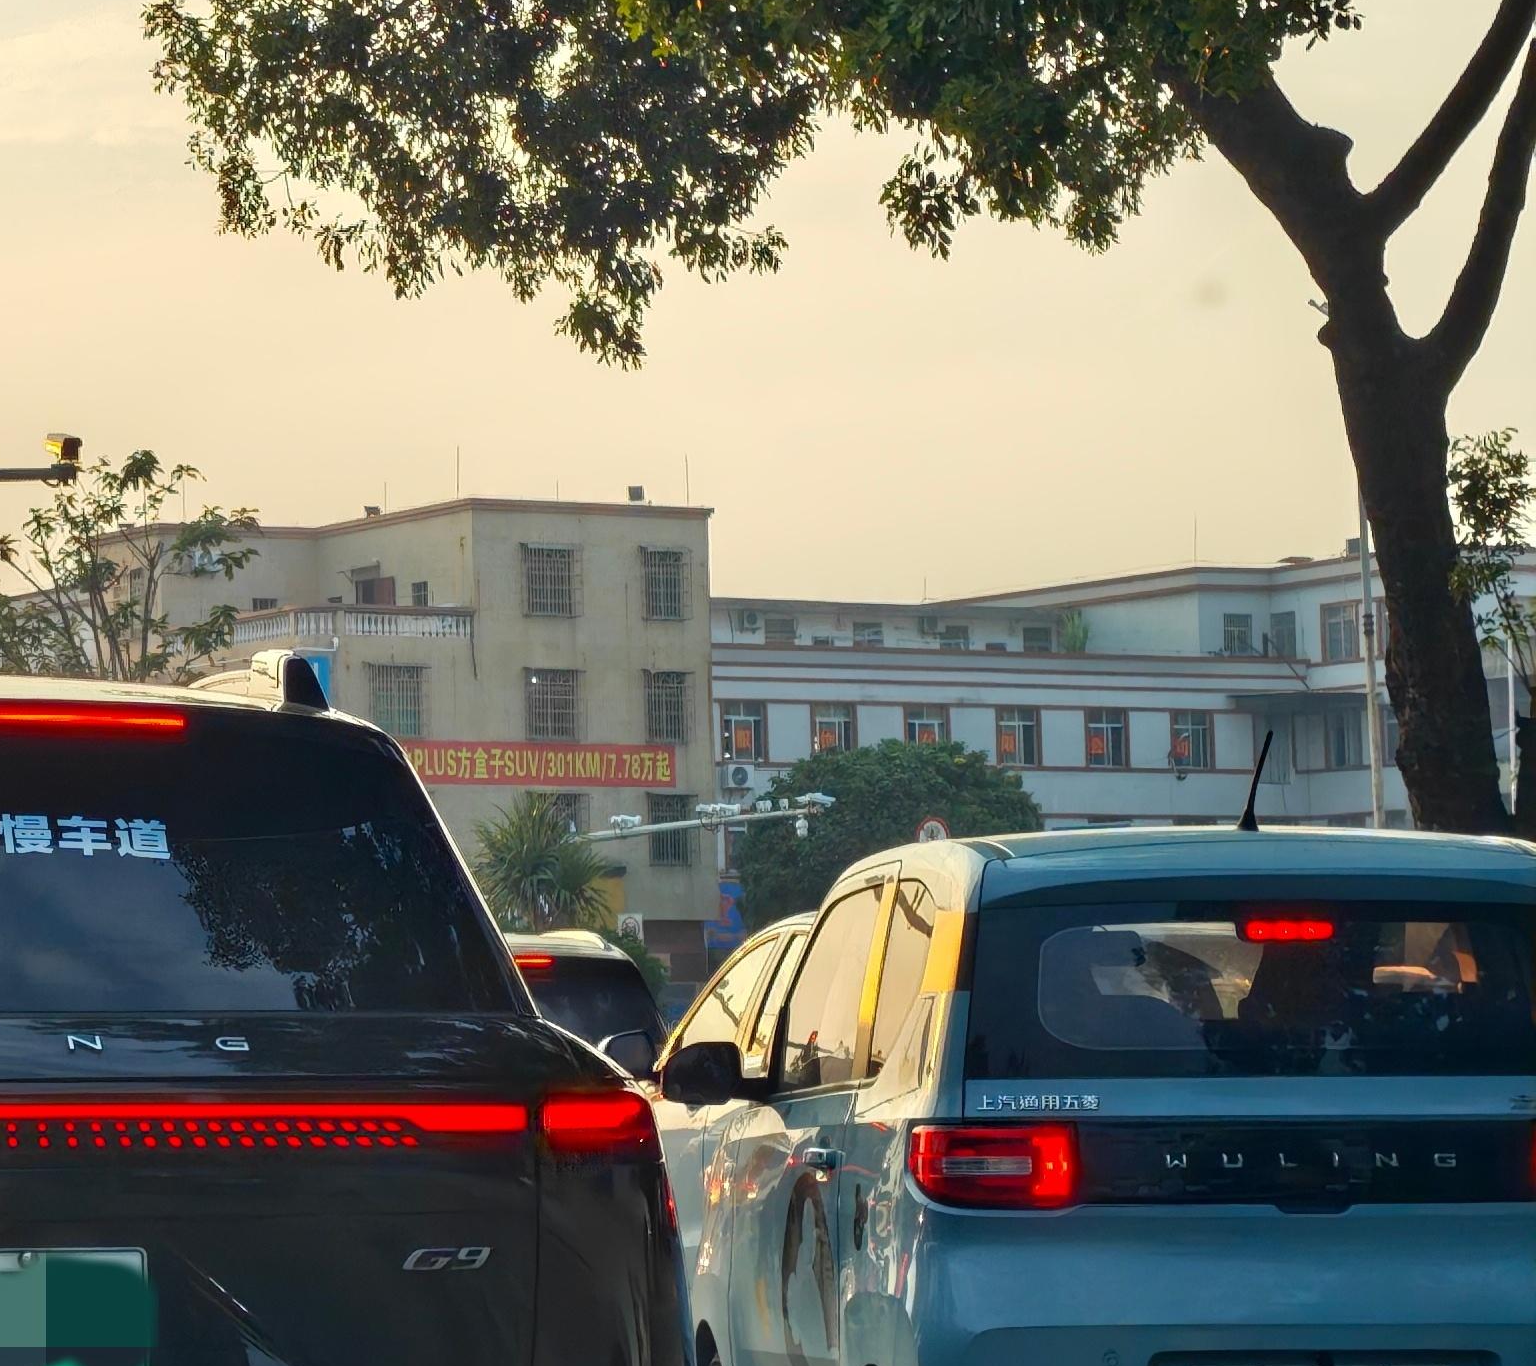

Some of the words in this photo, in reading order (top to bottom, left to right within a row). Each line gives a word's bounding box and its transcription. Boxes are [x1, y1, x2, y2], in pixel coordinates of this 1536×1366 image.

[407, 745, 671, 782] PLUS方盒子SUV/301KM/7.78万起
[976, 1094, 1100, 1111] 上汽通用五菱
[1164, 1151, 1458, 1170] WULING
[402, 1246, 492, 1271] G9
